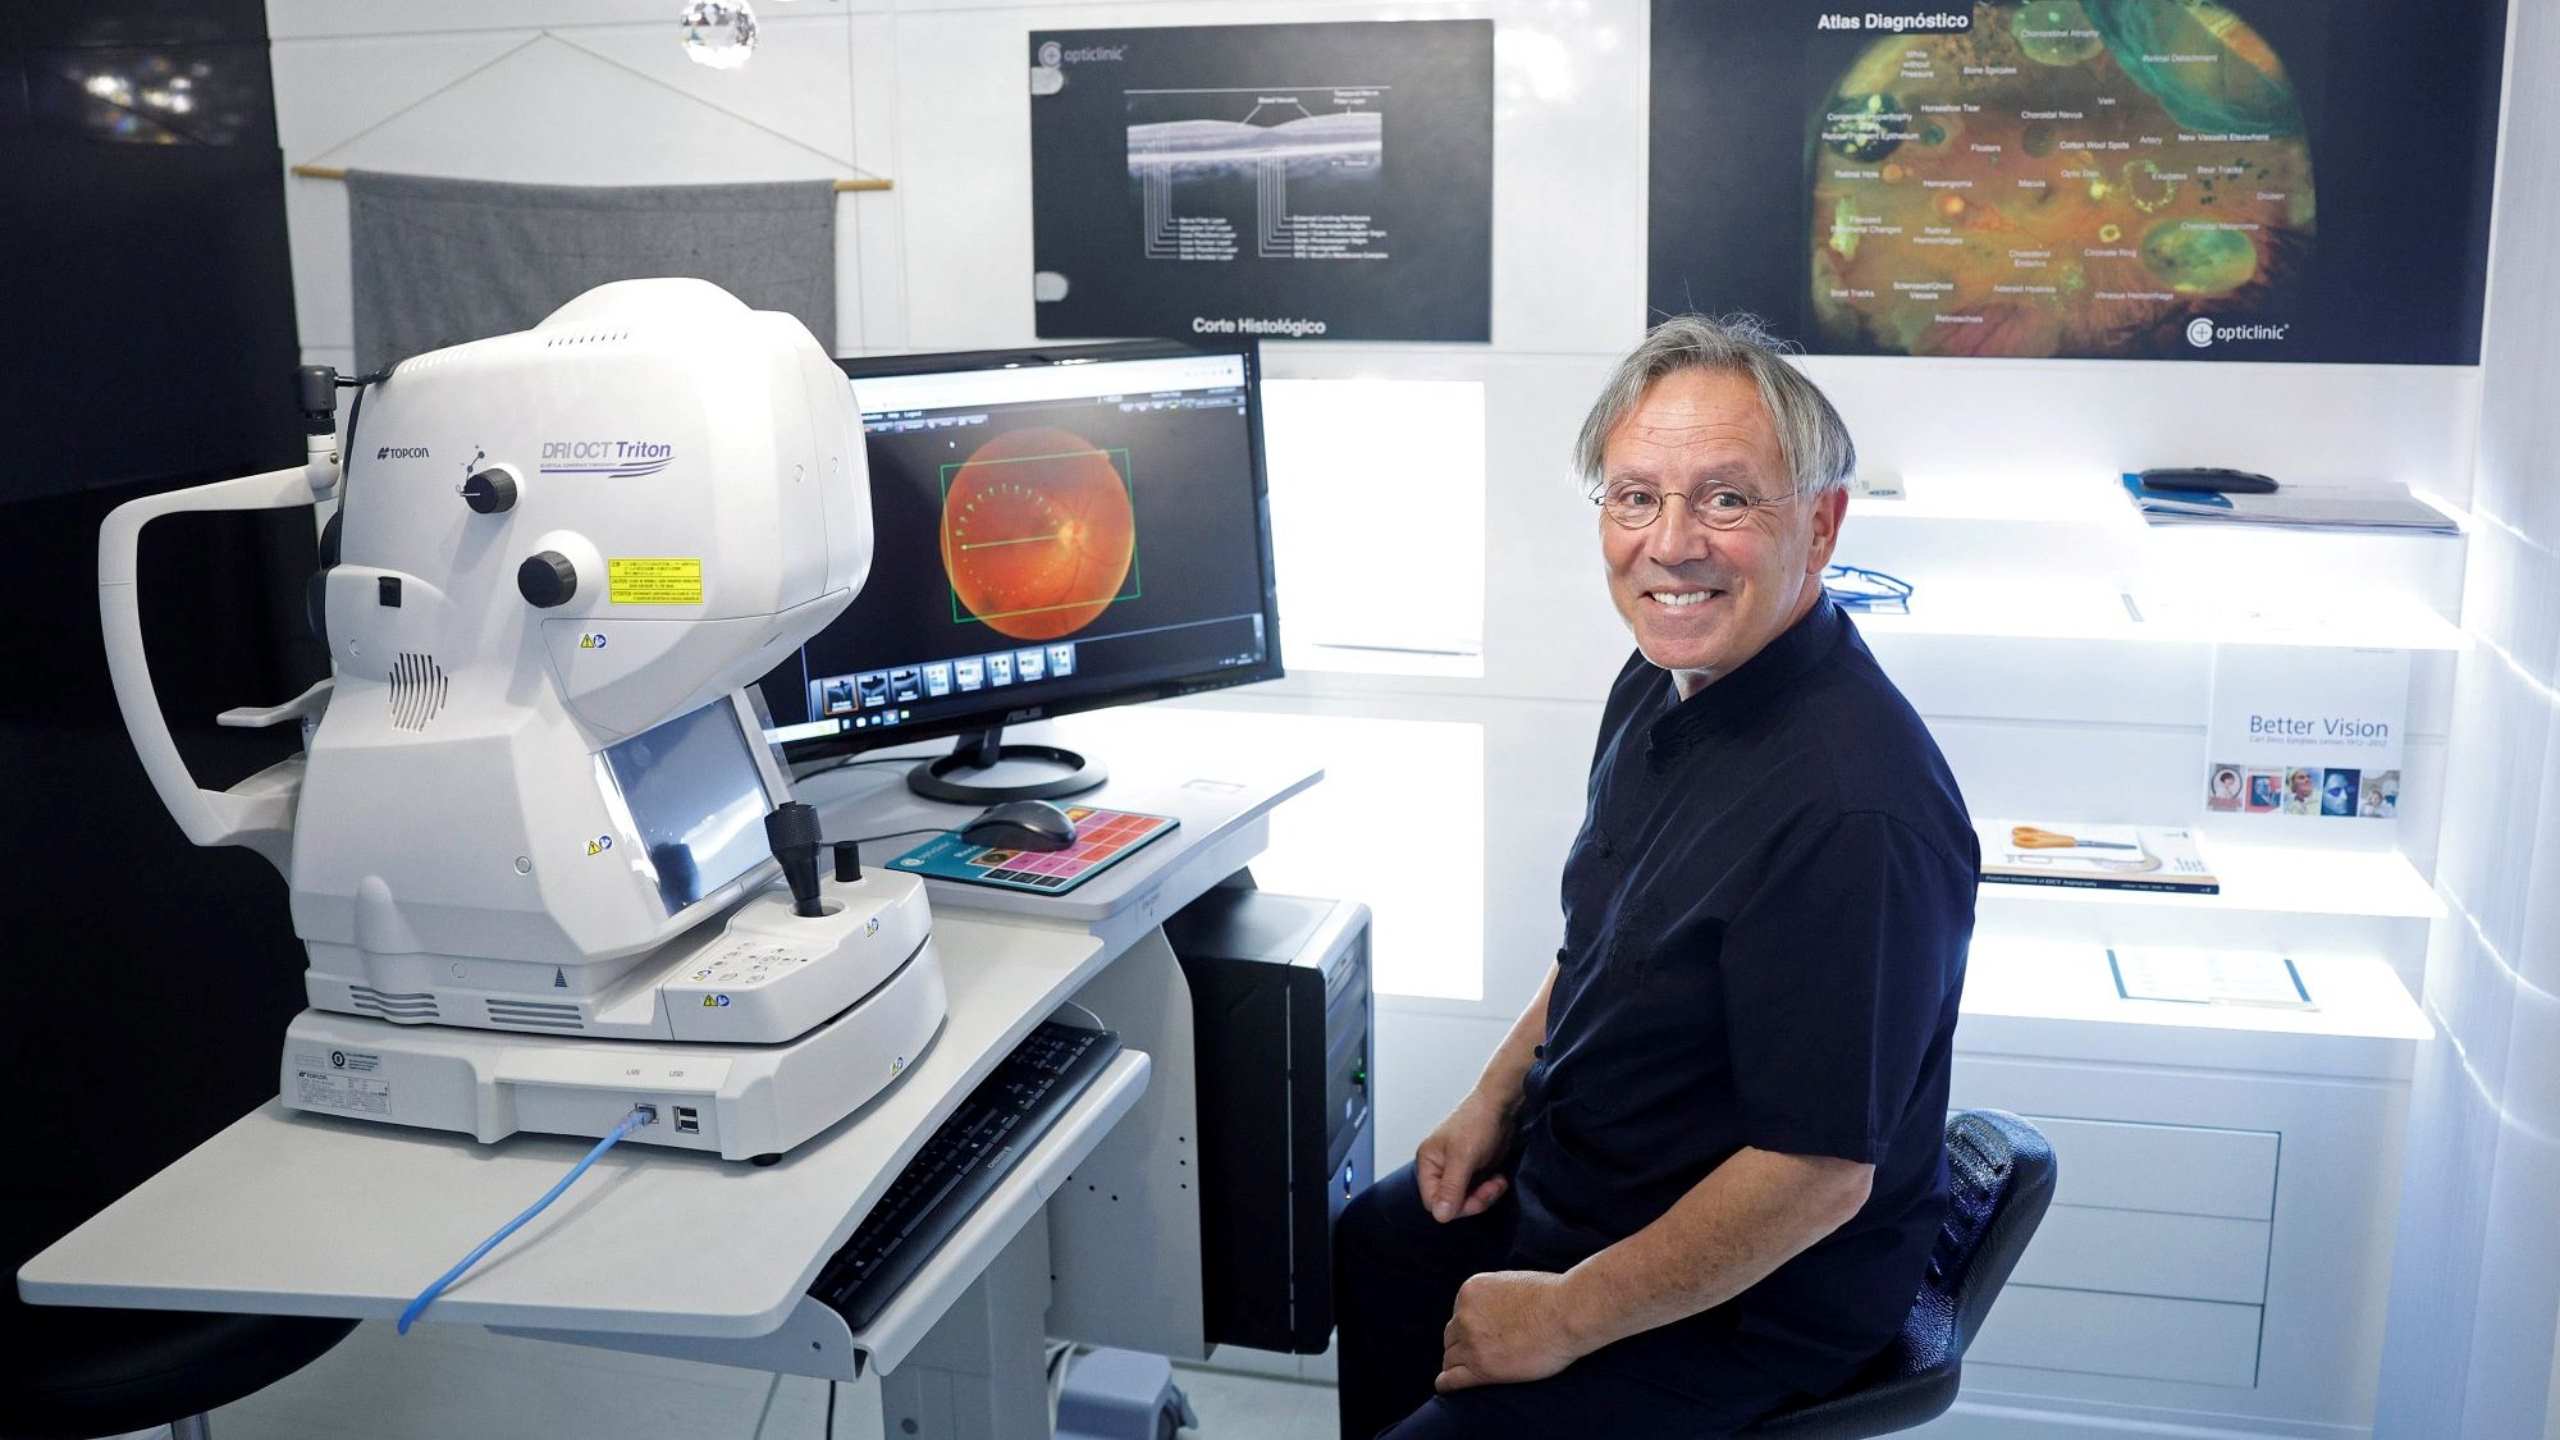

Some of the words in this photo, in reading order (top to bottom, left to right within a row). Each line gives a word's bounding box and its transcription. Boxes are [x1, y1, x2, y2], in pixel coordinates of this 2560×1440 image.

[1817, 13, 1860, 29] Atlas
[1865, 12, 1969, 31] Diagnóstico
[1064, 46, 1123, 64] opticlinic
[2178, 133, 2196, 141] New
[1192, 317, 1236, 333] Corte
[1238, 318, 1326, 337] Histológico
[2216, 324, 2285, 342] opticlinic
[391, 447, 430, 459] TOPCON
[542, 442, 572, 459] DRI
[573, 442, 613, 459] OCT
[616, 441, 672, 458] Triton
[2250, 715, 2315, 736] Better
[2323, 718, 2389, 737] Vision
